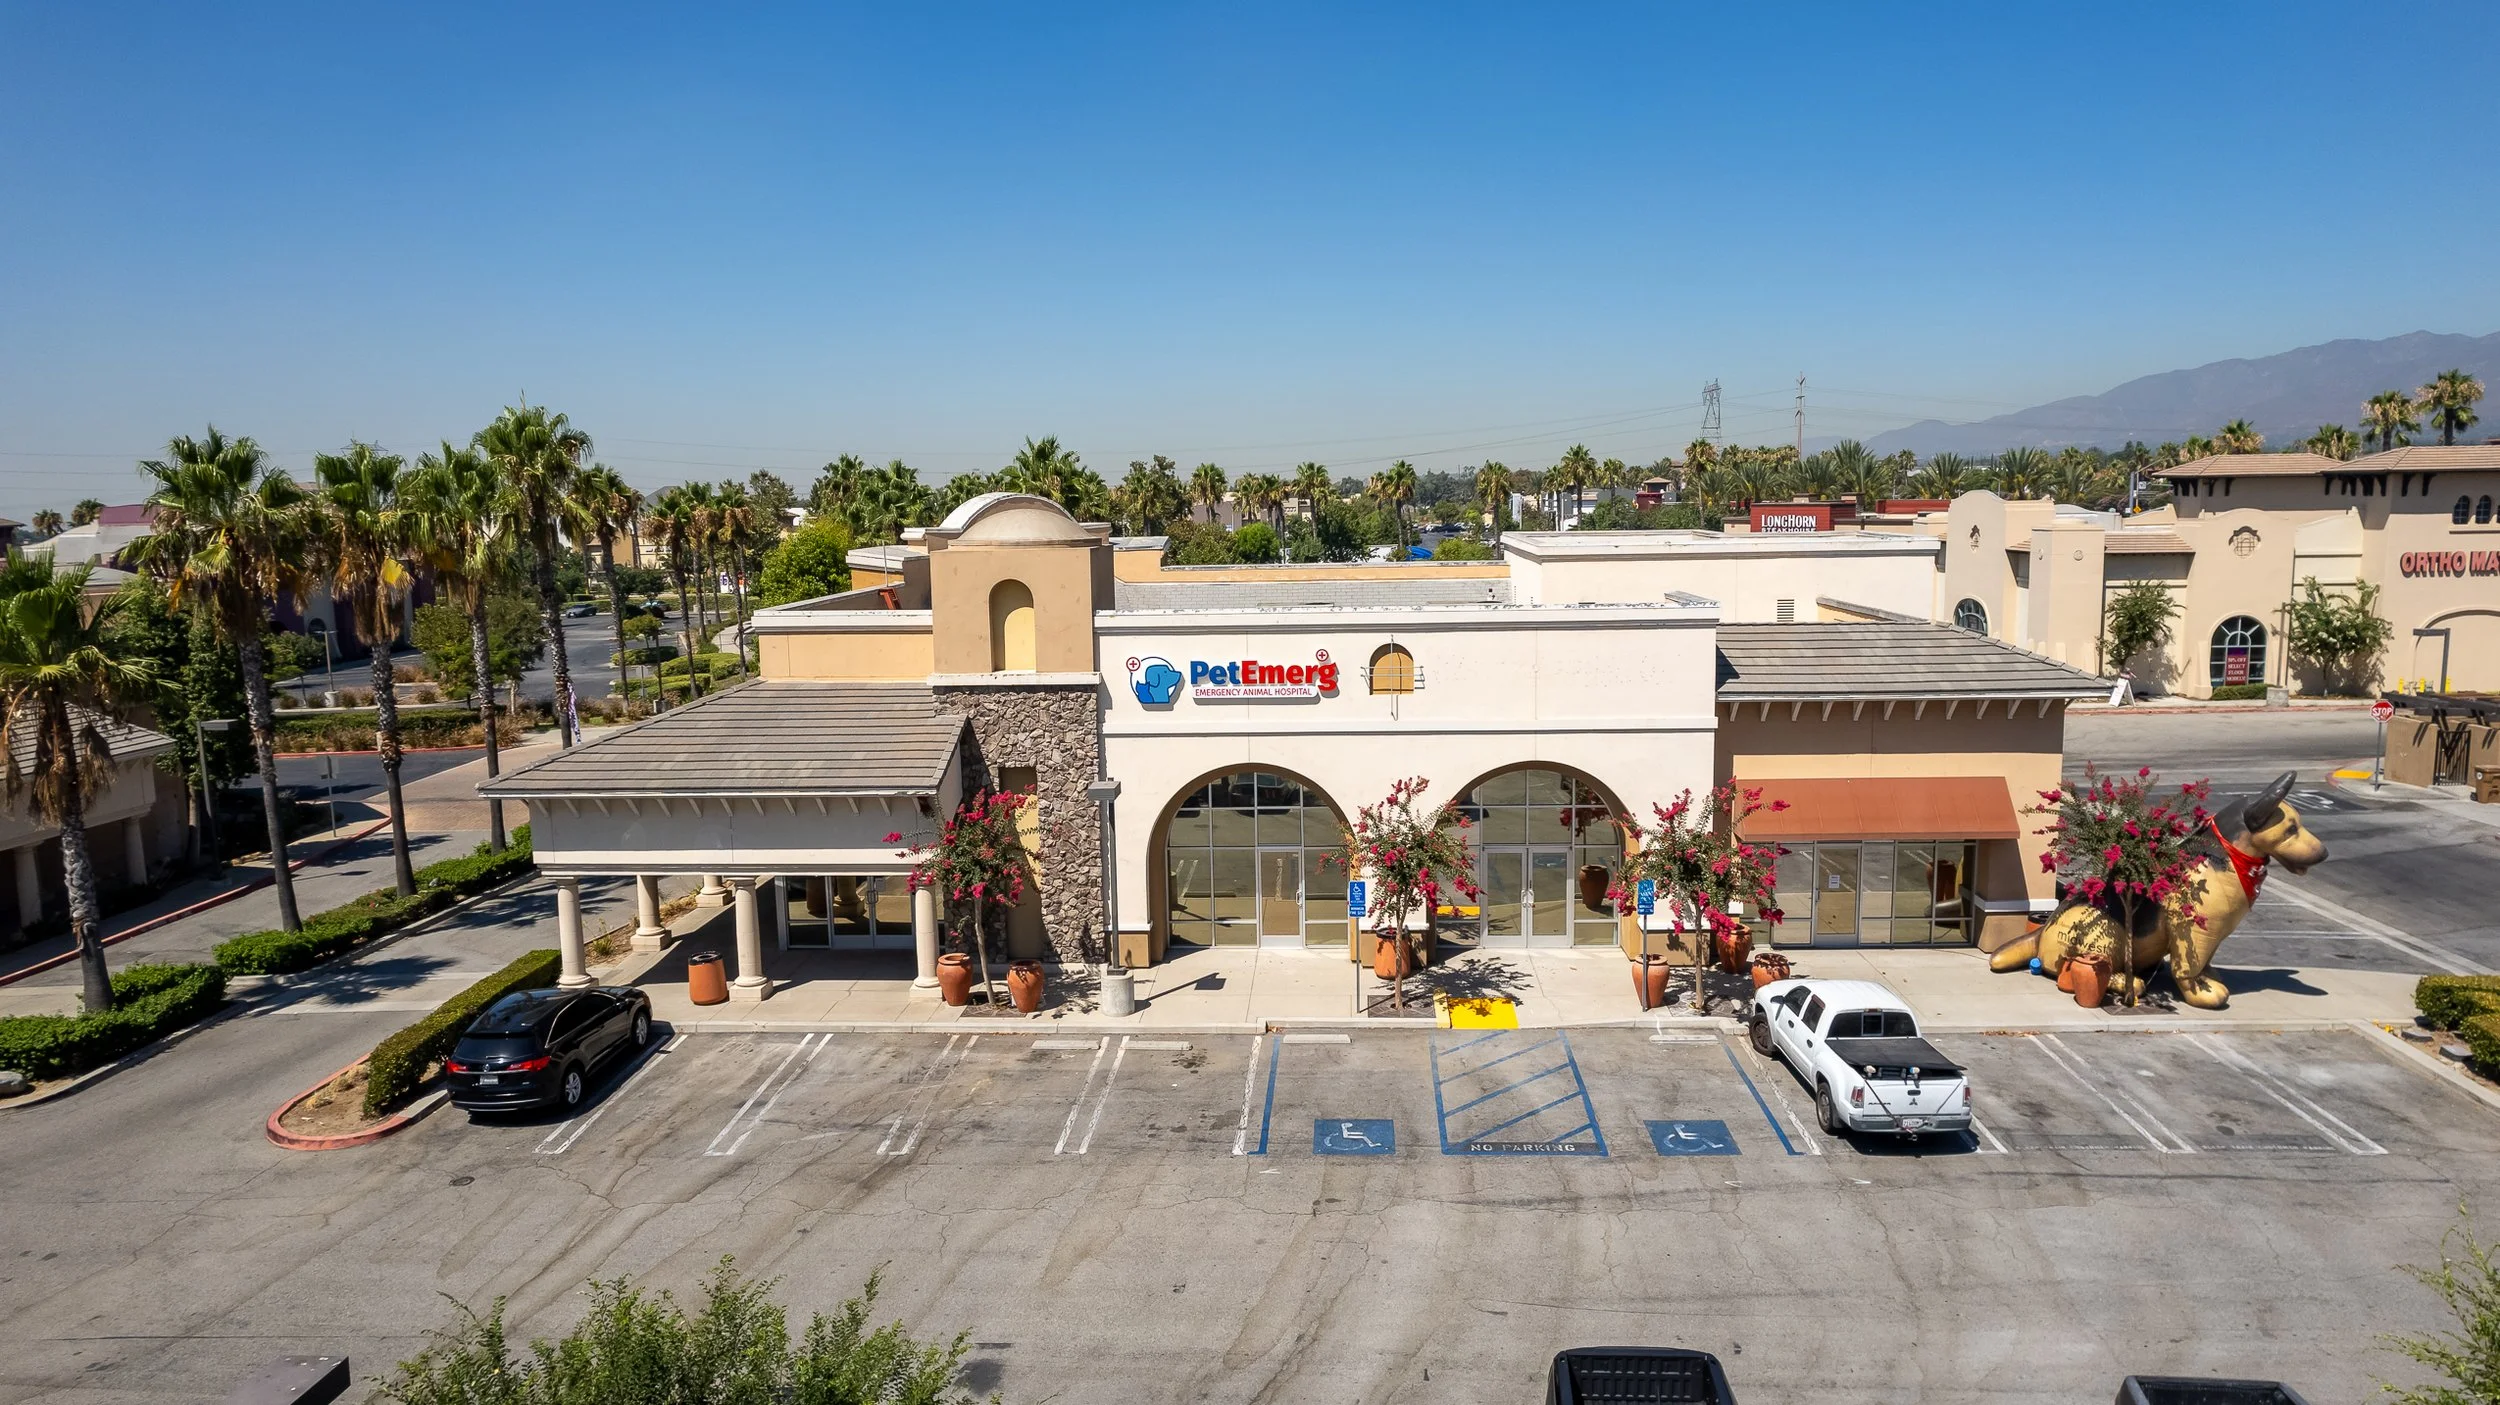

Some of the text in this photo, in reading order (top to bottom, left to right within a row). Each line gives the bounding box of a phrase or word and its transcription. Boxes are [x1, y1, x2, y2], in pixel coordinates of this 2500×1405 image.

[1761, 514, 1817, 528] LONGHORN
[2400, 550, 2500, 574] ORTHO MA
[1190, 660, 1337, 692] PetEmerg
[1195, 687, 1312, 697] EMERGENCY ANIMAL HOSPITAL
[2372, 707, 2392, 717] STOP
[2057, 930, 2108, 954] midwest
[1470, 1143, 1576, 1152] NO PARKING
